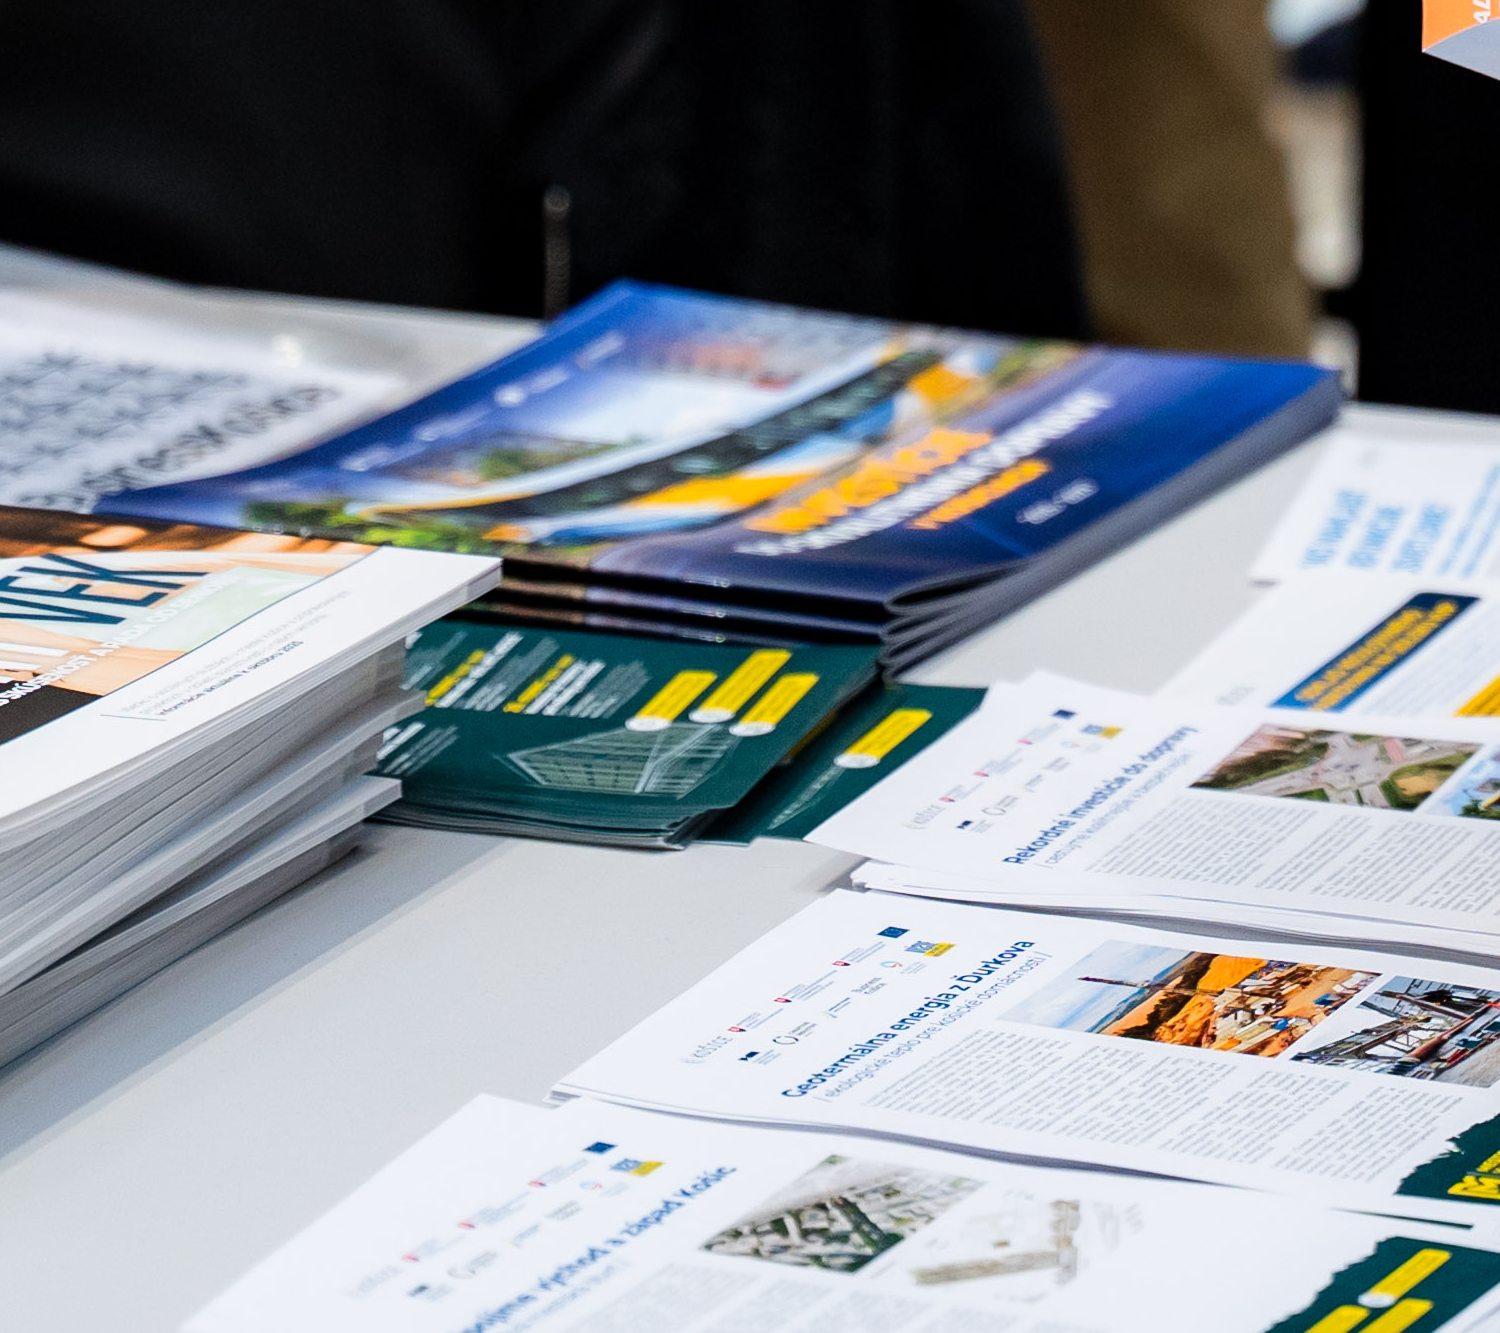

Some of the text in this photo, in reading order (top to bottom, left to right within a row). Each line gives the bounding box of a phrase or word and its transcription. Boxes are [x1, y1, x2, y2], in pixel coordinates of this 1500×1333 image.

[1002, 817, 1078, 866] Rekordné
[1068, 773, 1130, 821] investície
[781, 940, 1037, 1098] Geotermálna energia z Ďurkova
